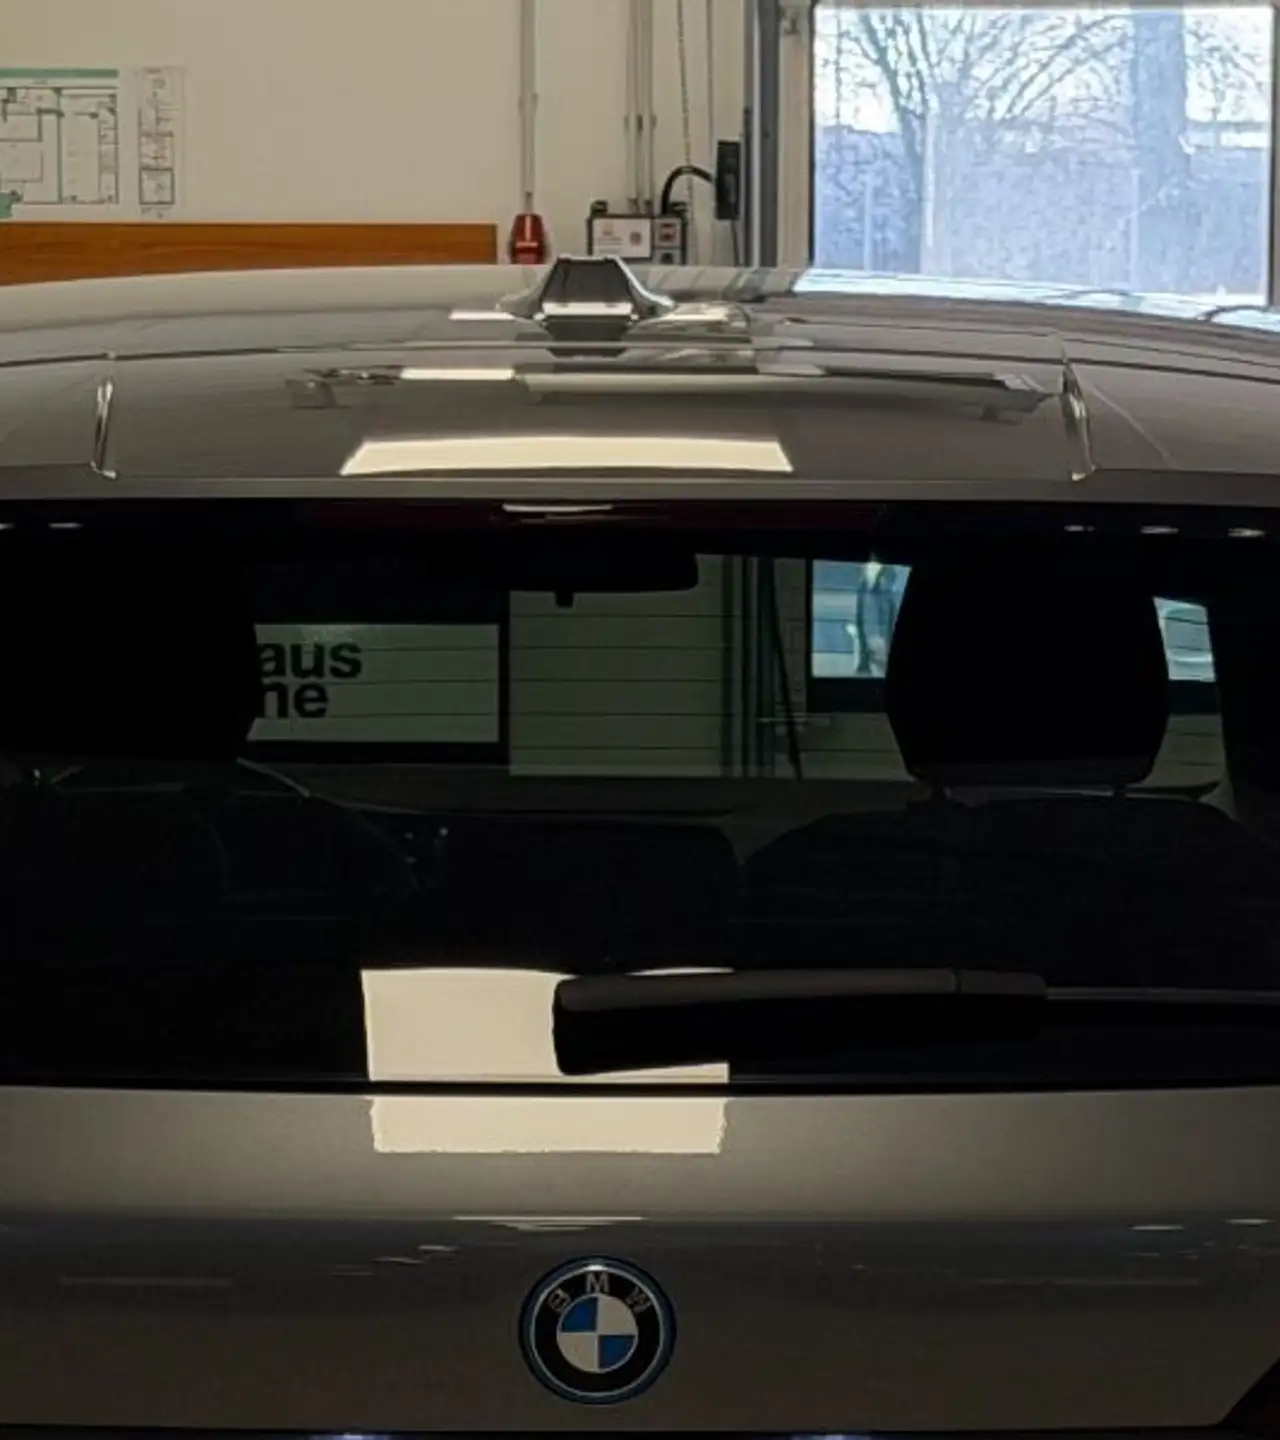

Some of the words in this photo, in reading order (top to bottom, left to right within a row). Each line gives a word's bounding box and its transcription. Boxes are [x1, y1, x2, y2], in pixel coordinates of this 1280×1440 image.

[255, 642, 362, 678] aus
[255, 681, 328, 718] ne
[547, 1272, 652, 1312] BMW
